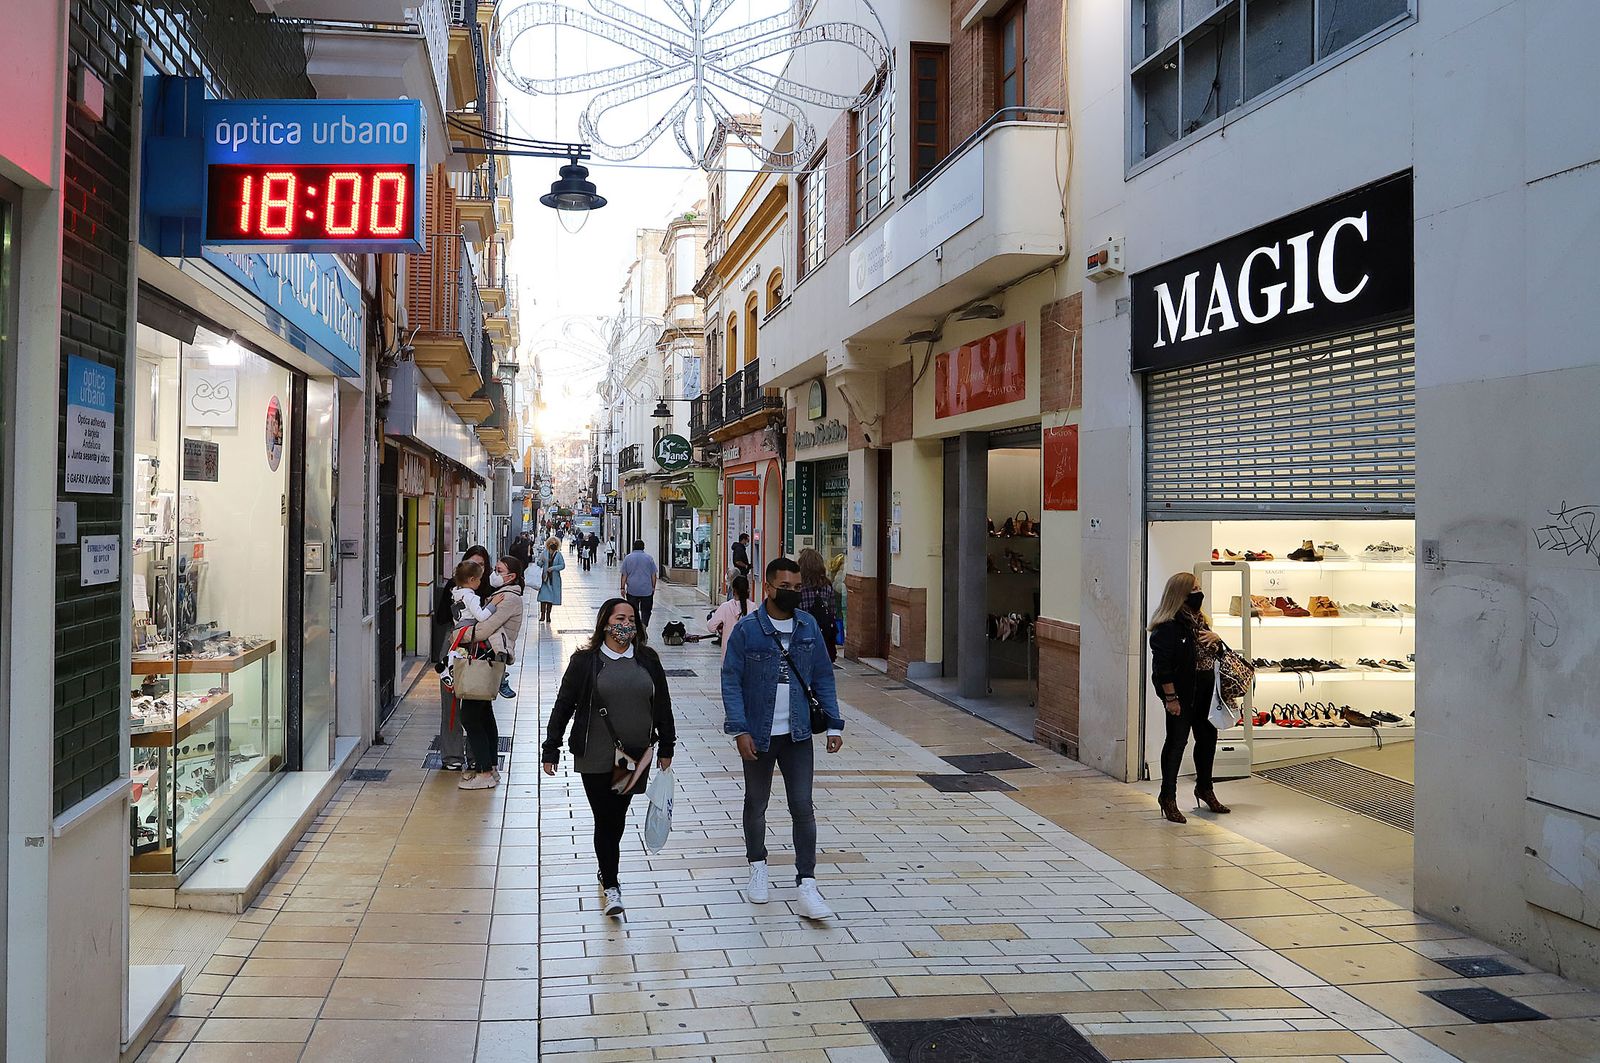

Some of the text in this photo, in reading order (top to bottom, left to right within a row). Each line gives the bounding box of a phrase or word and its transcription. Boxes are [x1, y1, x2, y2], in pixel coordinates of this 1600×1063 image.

[215, 115, 408, 152] óptica urbano
[240, 172, 406, 234] 18:00
[1153, 211, 1369, 348] MAGIC
[83, 368, 106, 390] óptica
[80, 386, 106, 407] urbano
[70, 473, 84, 484] GAFAS
